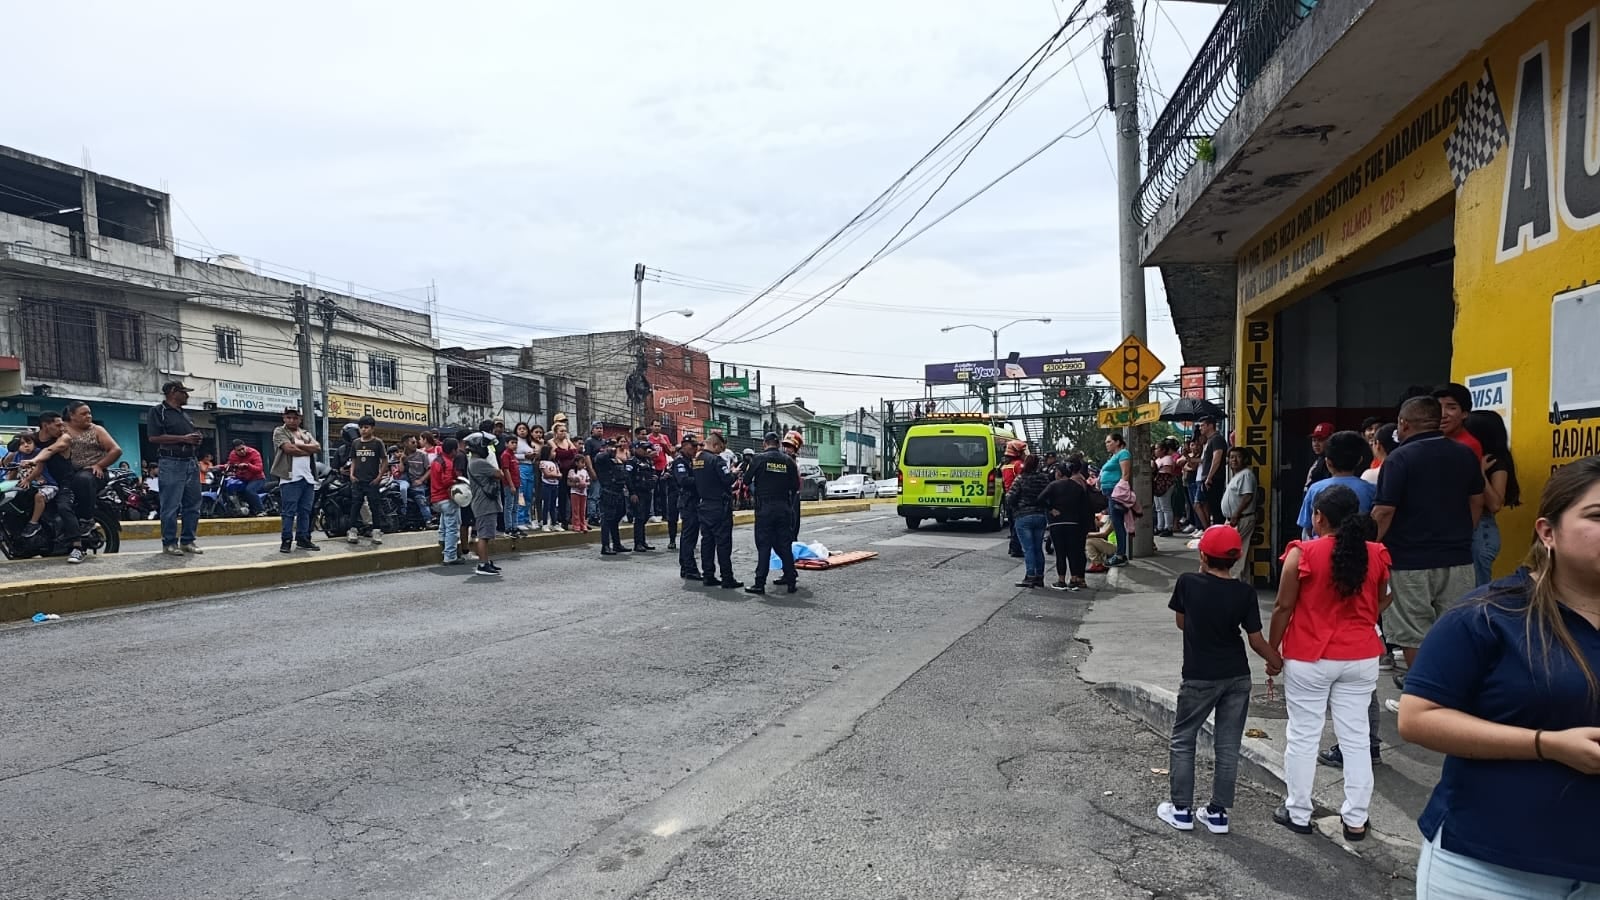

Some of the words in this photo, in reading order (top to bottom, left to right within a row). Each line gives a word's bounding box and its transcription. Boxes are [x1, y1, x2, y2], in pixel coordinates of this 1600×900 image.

[1262, 231, 1278, 262] DIOS
[1279, 217, 1296, 250] HIZO
[1297, 204, 1313, 237] POR
[1314, 164, 1362, 225] NOSOTROS
[1365, 147, 1384, 188] FUE
[1385, 80, 1469, 174] MARAVILLOSO
[1341, 201, 1373, 242] SALMOS
[1380, 179, 1406, 217] 126:3
[1279, 255, 1289, 280] DE
[228, 398, 265, 410] innova
[1471, 386, 1503, 408] VISA
[364, 404, 428, 422] Electrónica
[918, 496, 971, 504] GUATEMALA
[960, 484, 985, 497] 123
